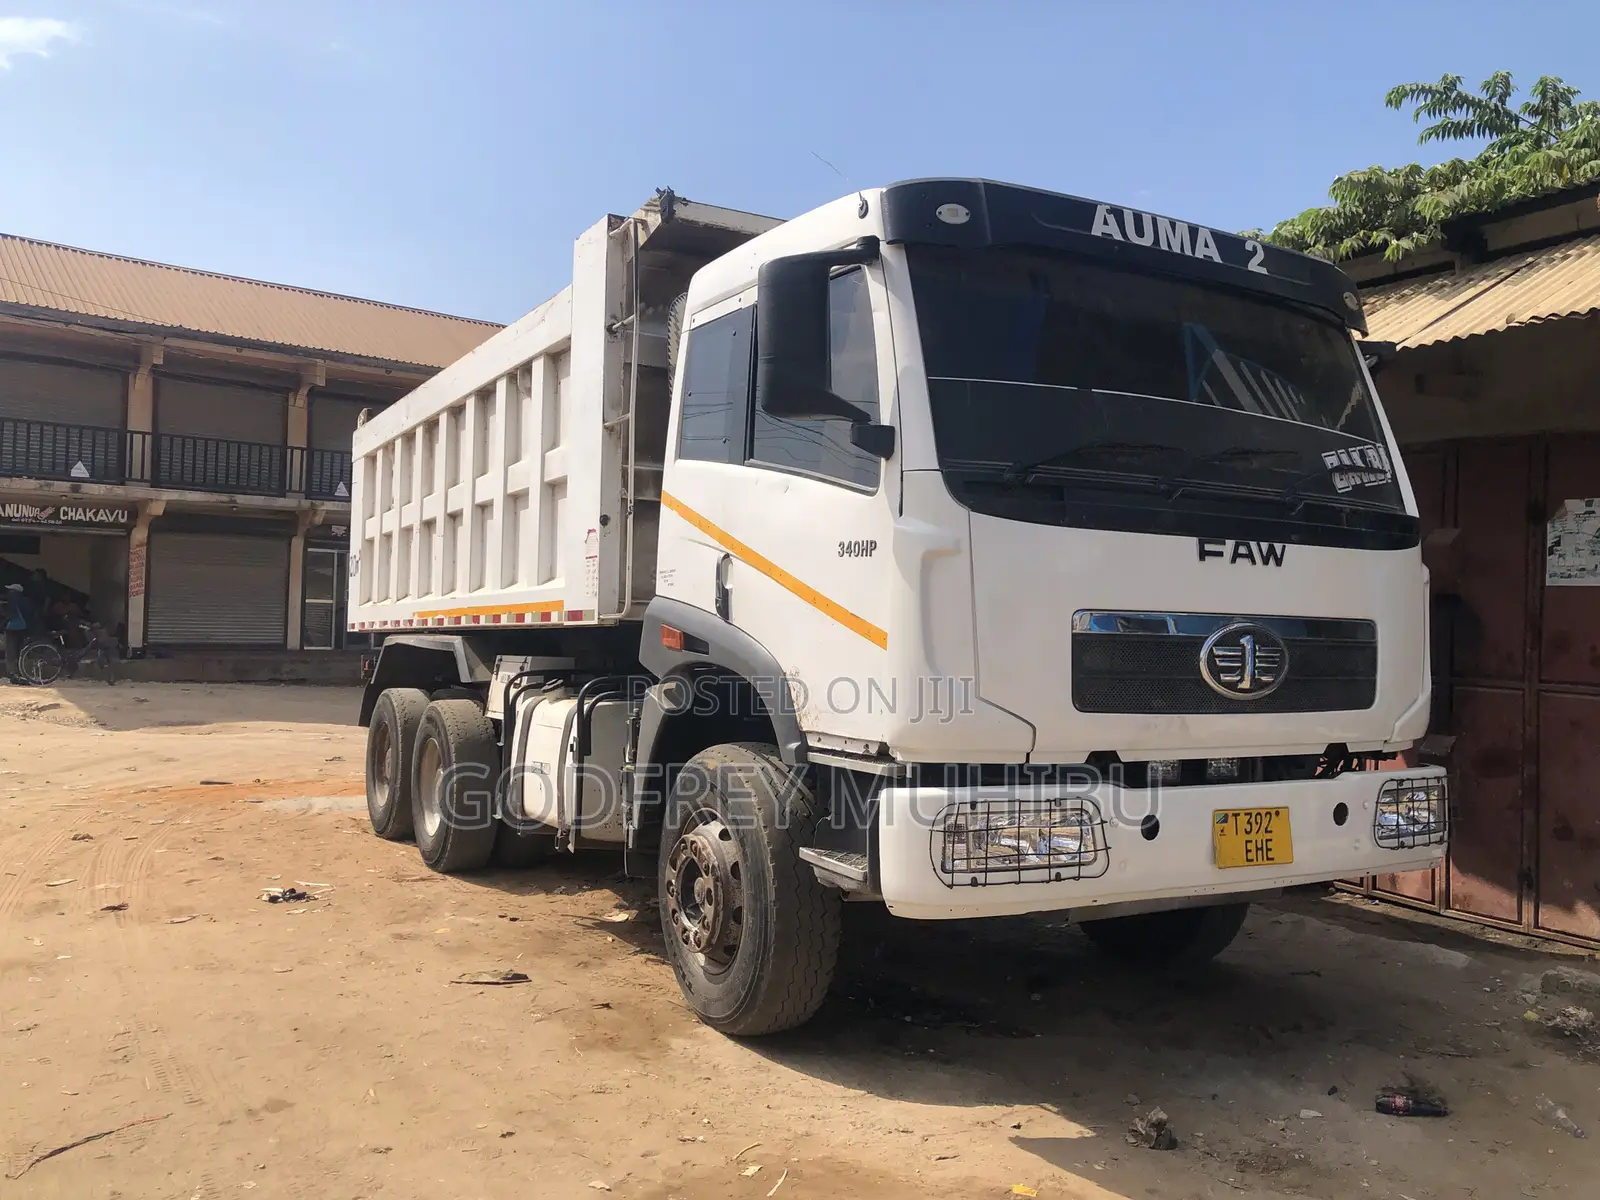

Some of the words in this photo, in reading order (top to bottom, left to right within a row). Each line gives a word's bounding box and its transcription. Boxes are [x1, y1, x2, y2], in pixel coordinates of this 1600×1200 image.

[1090, 204, 1223, 263] AUMA
[1244, 239, 1269, 275] 2
[60, 506, 128, 523] CHAKAVU
[838, 539, 877, 558] 340HP
[1197, 537, 1286, 567] FAW
[1244, 838, 1275, 862] EHE
